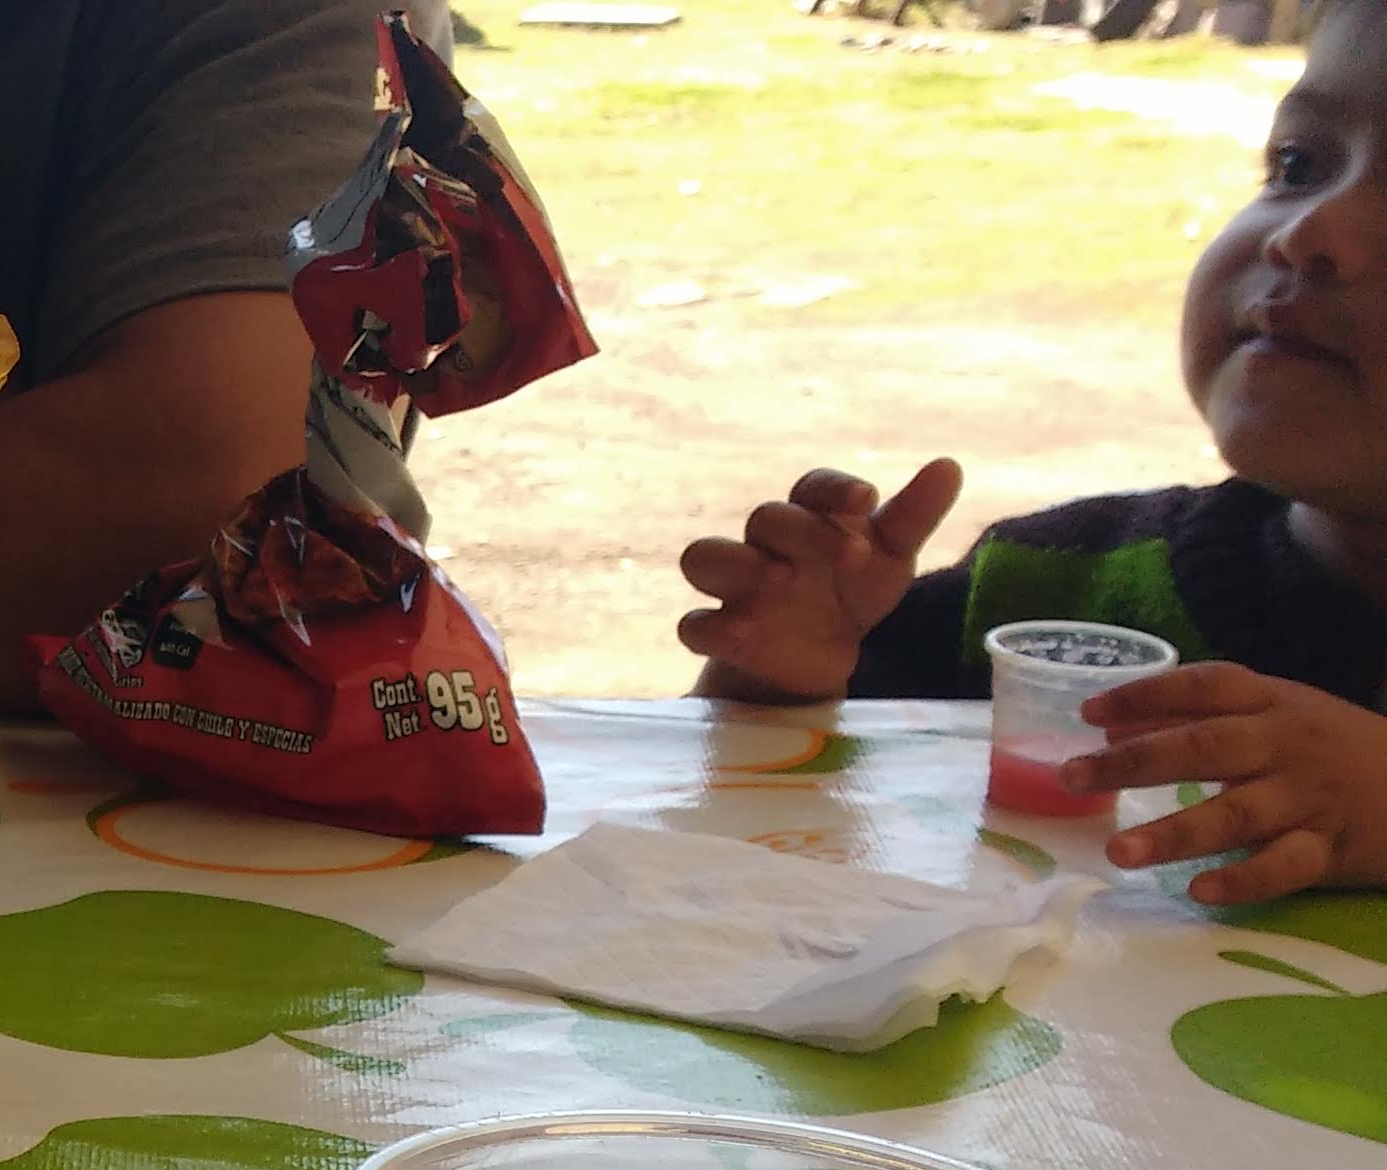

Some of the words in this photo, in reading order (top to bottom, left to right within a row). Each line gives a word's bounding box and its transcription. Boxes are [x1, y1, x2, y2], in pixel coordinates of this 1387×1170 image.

[172, 703, 197, 729] CON
[197, 708, 235, 738] CHILE
[237, 719, 252, 741] Y
[251, 723, 313, 754] ESPECIAS
[426, 670, 484, 730] 95
[485, 686, 508, 745] g
